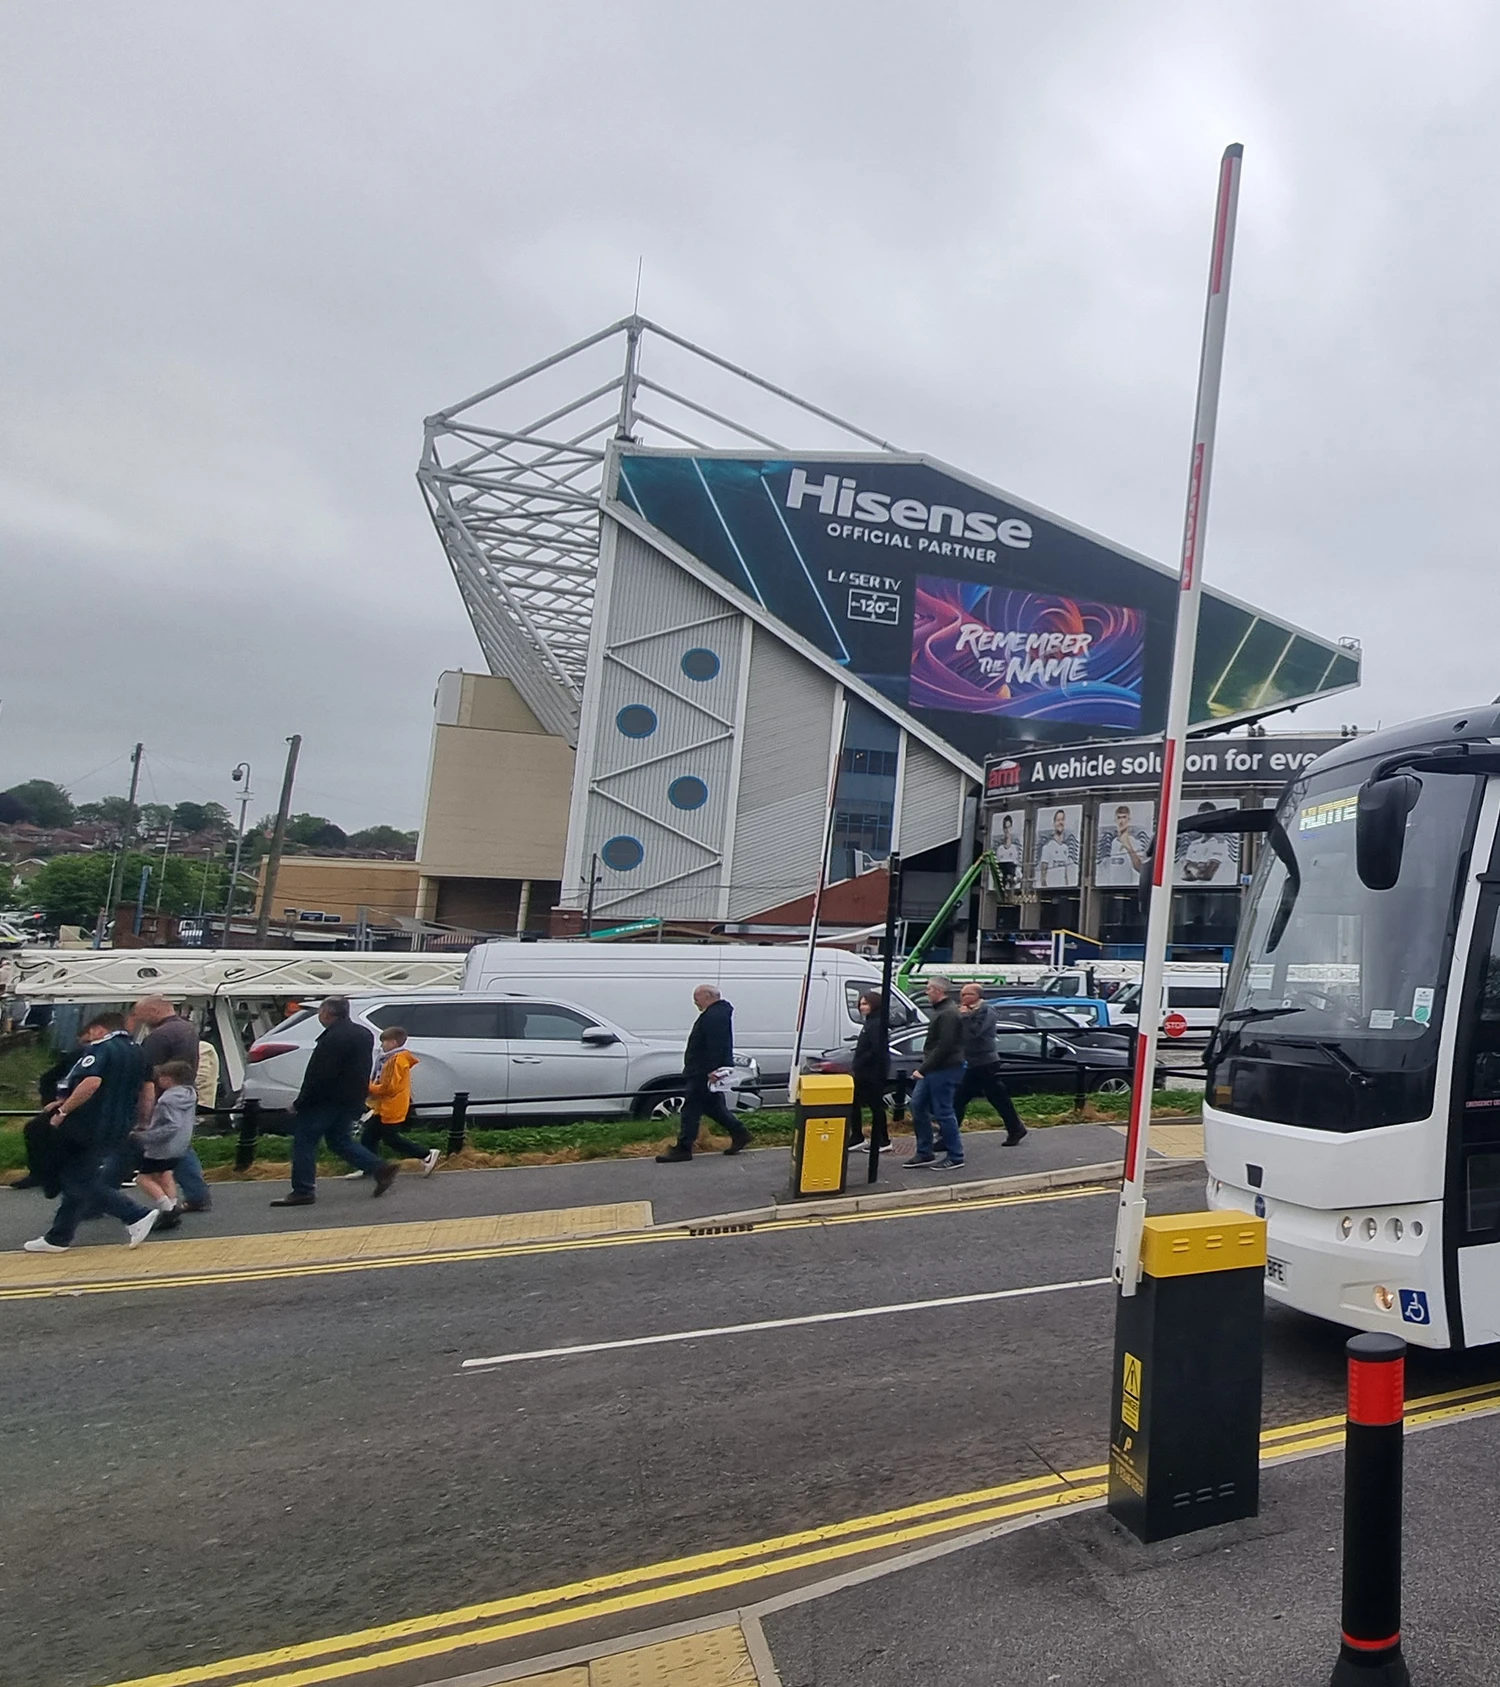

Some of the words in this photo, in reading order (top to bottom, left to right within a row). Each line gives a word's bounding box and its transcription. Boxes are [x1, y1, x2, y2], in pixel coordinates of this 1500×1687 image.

[786, 468, 1033, 549] Hisense
[827, 522, 912, 550] OFFICIAL
[918, 537, 997, 564] PARTNER
[884, 578, 902, 591] TV
[956, 623, 1093, 658] REMEMBER
[978, 656, 1006, 676] THE
[1030, 761, 1045, 782] A
[1048, 753, 1117, 780] vehicle
[1121, 751, 1217, 775] solon
[1225, 749, 1263, 772] for
[1164, 1021, 1186, 1030] STOP
